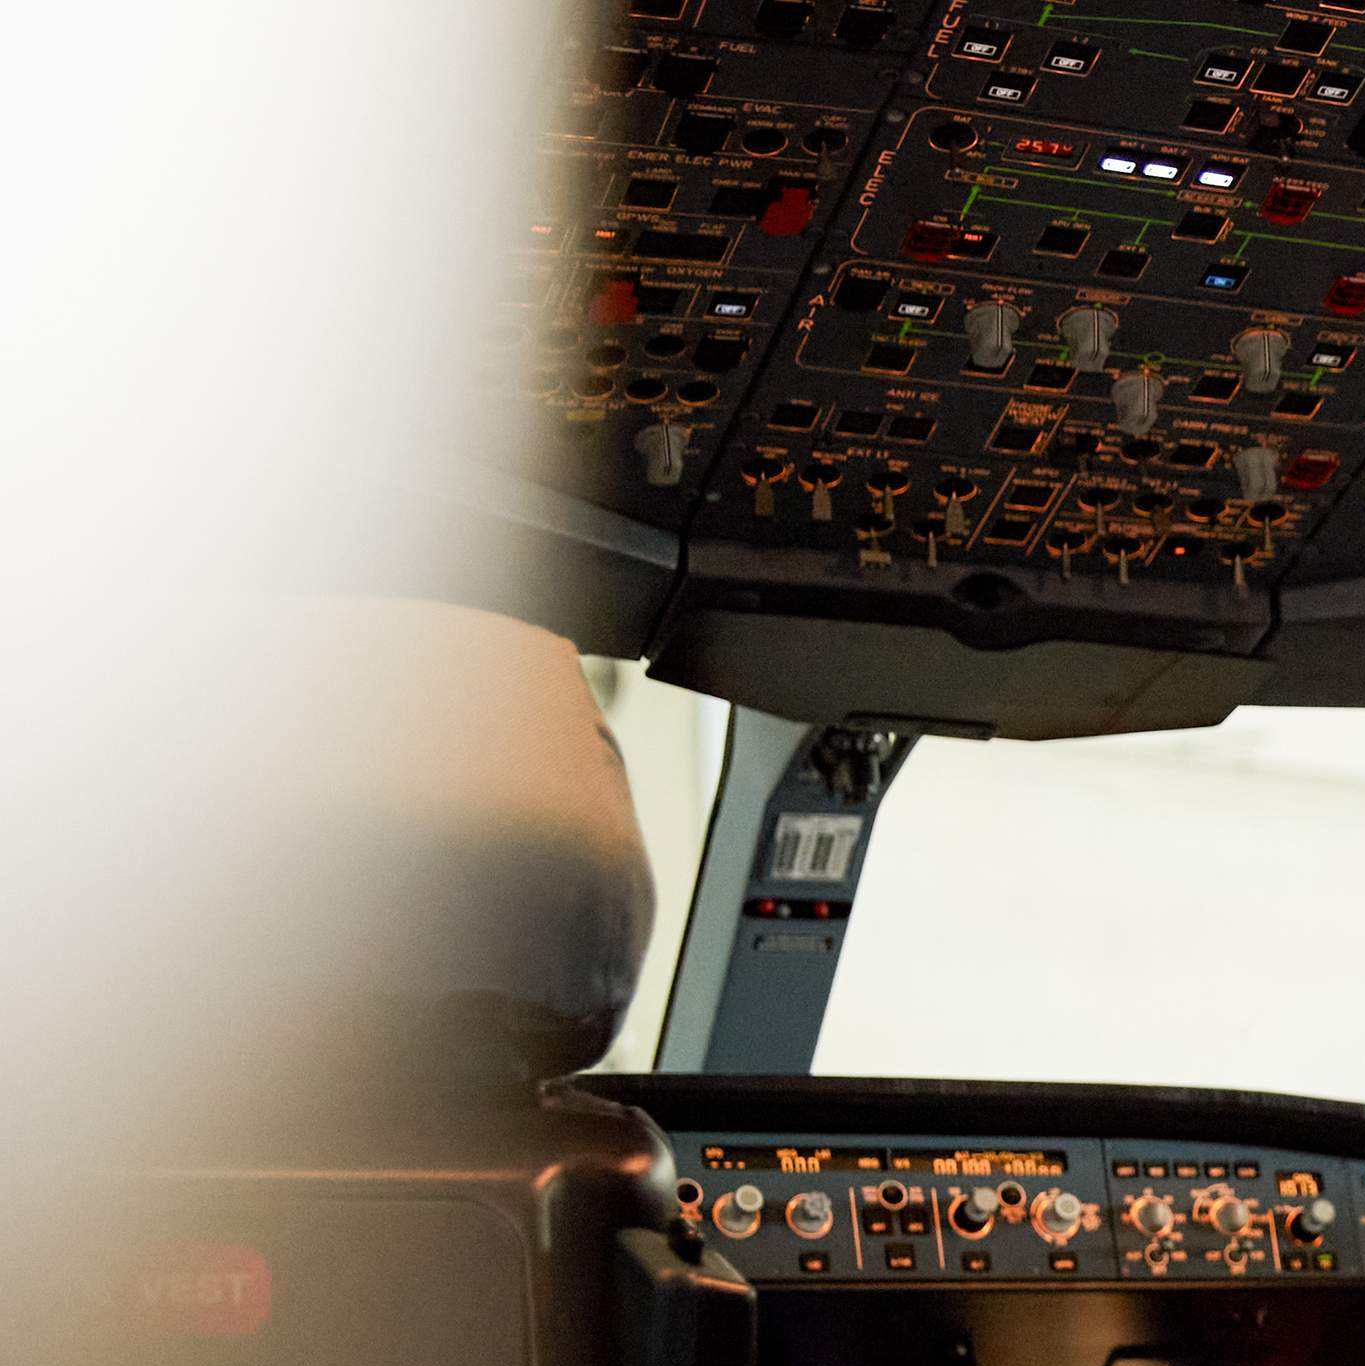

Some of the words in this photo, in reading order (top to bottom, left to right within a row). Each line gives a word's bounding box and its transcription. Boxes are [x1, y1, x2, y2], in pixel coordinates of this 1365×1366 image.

[742, 101, 783, 115] EVAC
[717, 157, 754, 169] PWR
[666, 265, 724, 279] OXYGEN
